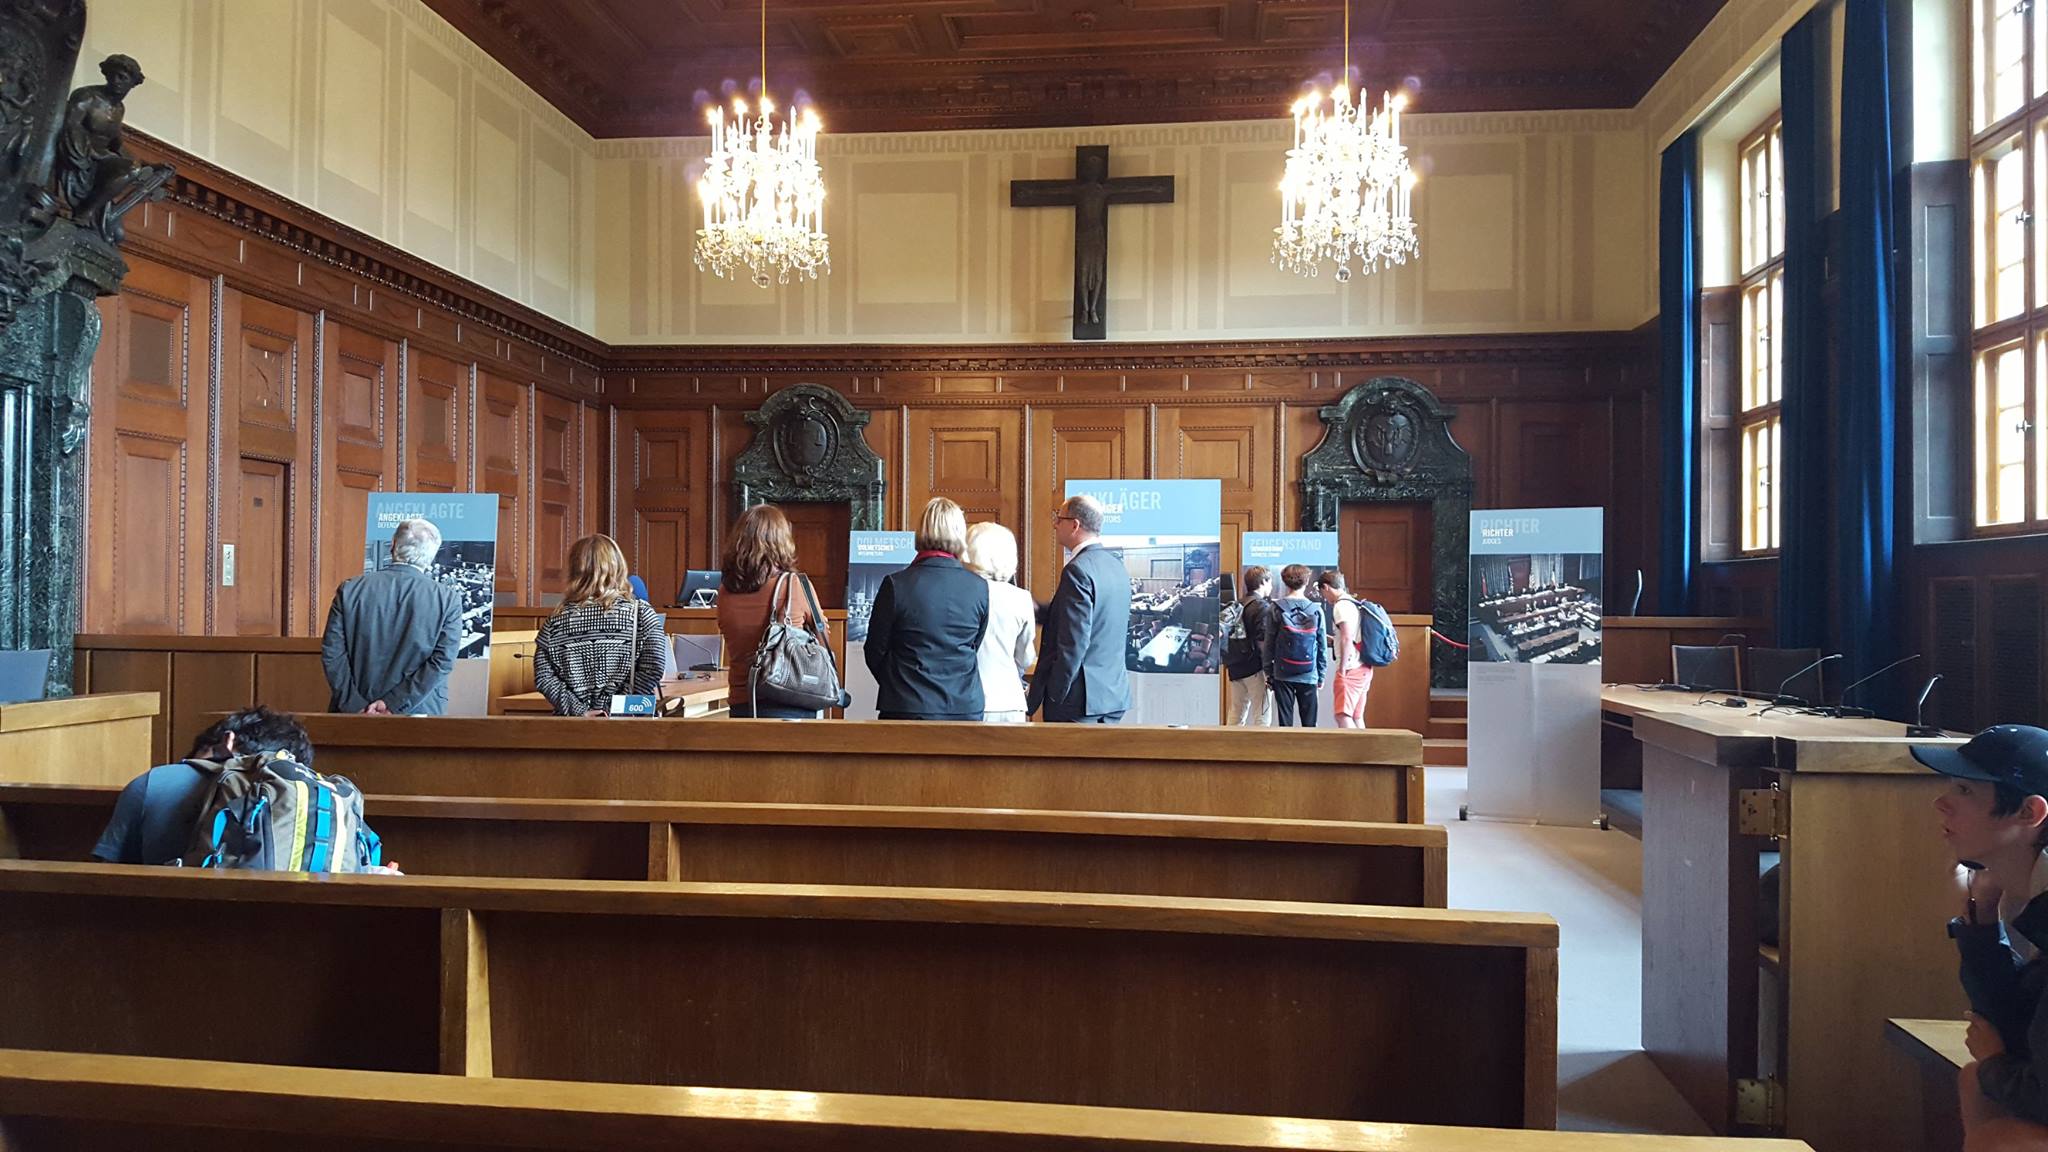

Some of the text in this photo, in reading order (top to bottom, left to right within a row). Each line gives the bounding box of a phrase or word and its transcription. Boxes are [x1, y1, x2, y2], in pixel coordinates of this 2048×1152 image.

[377, 502, 464, 519] ANGEKLAGTE
[1480, 518, 1540, 534] RICHTER
[1482, 528, 1514, 537] RICHTER
[1250, 538, 1321, 551] ZEUGENSTAND
[629, 704, 644, 712] 600
